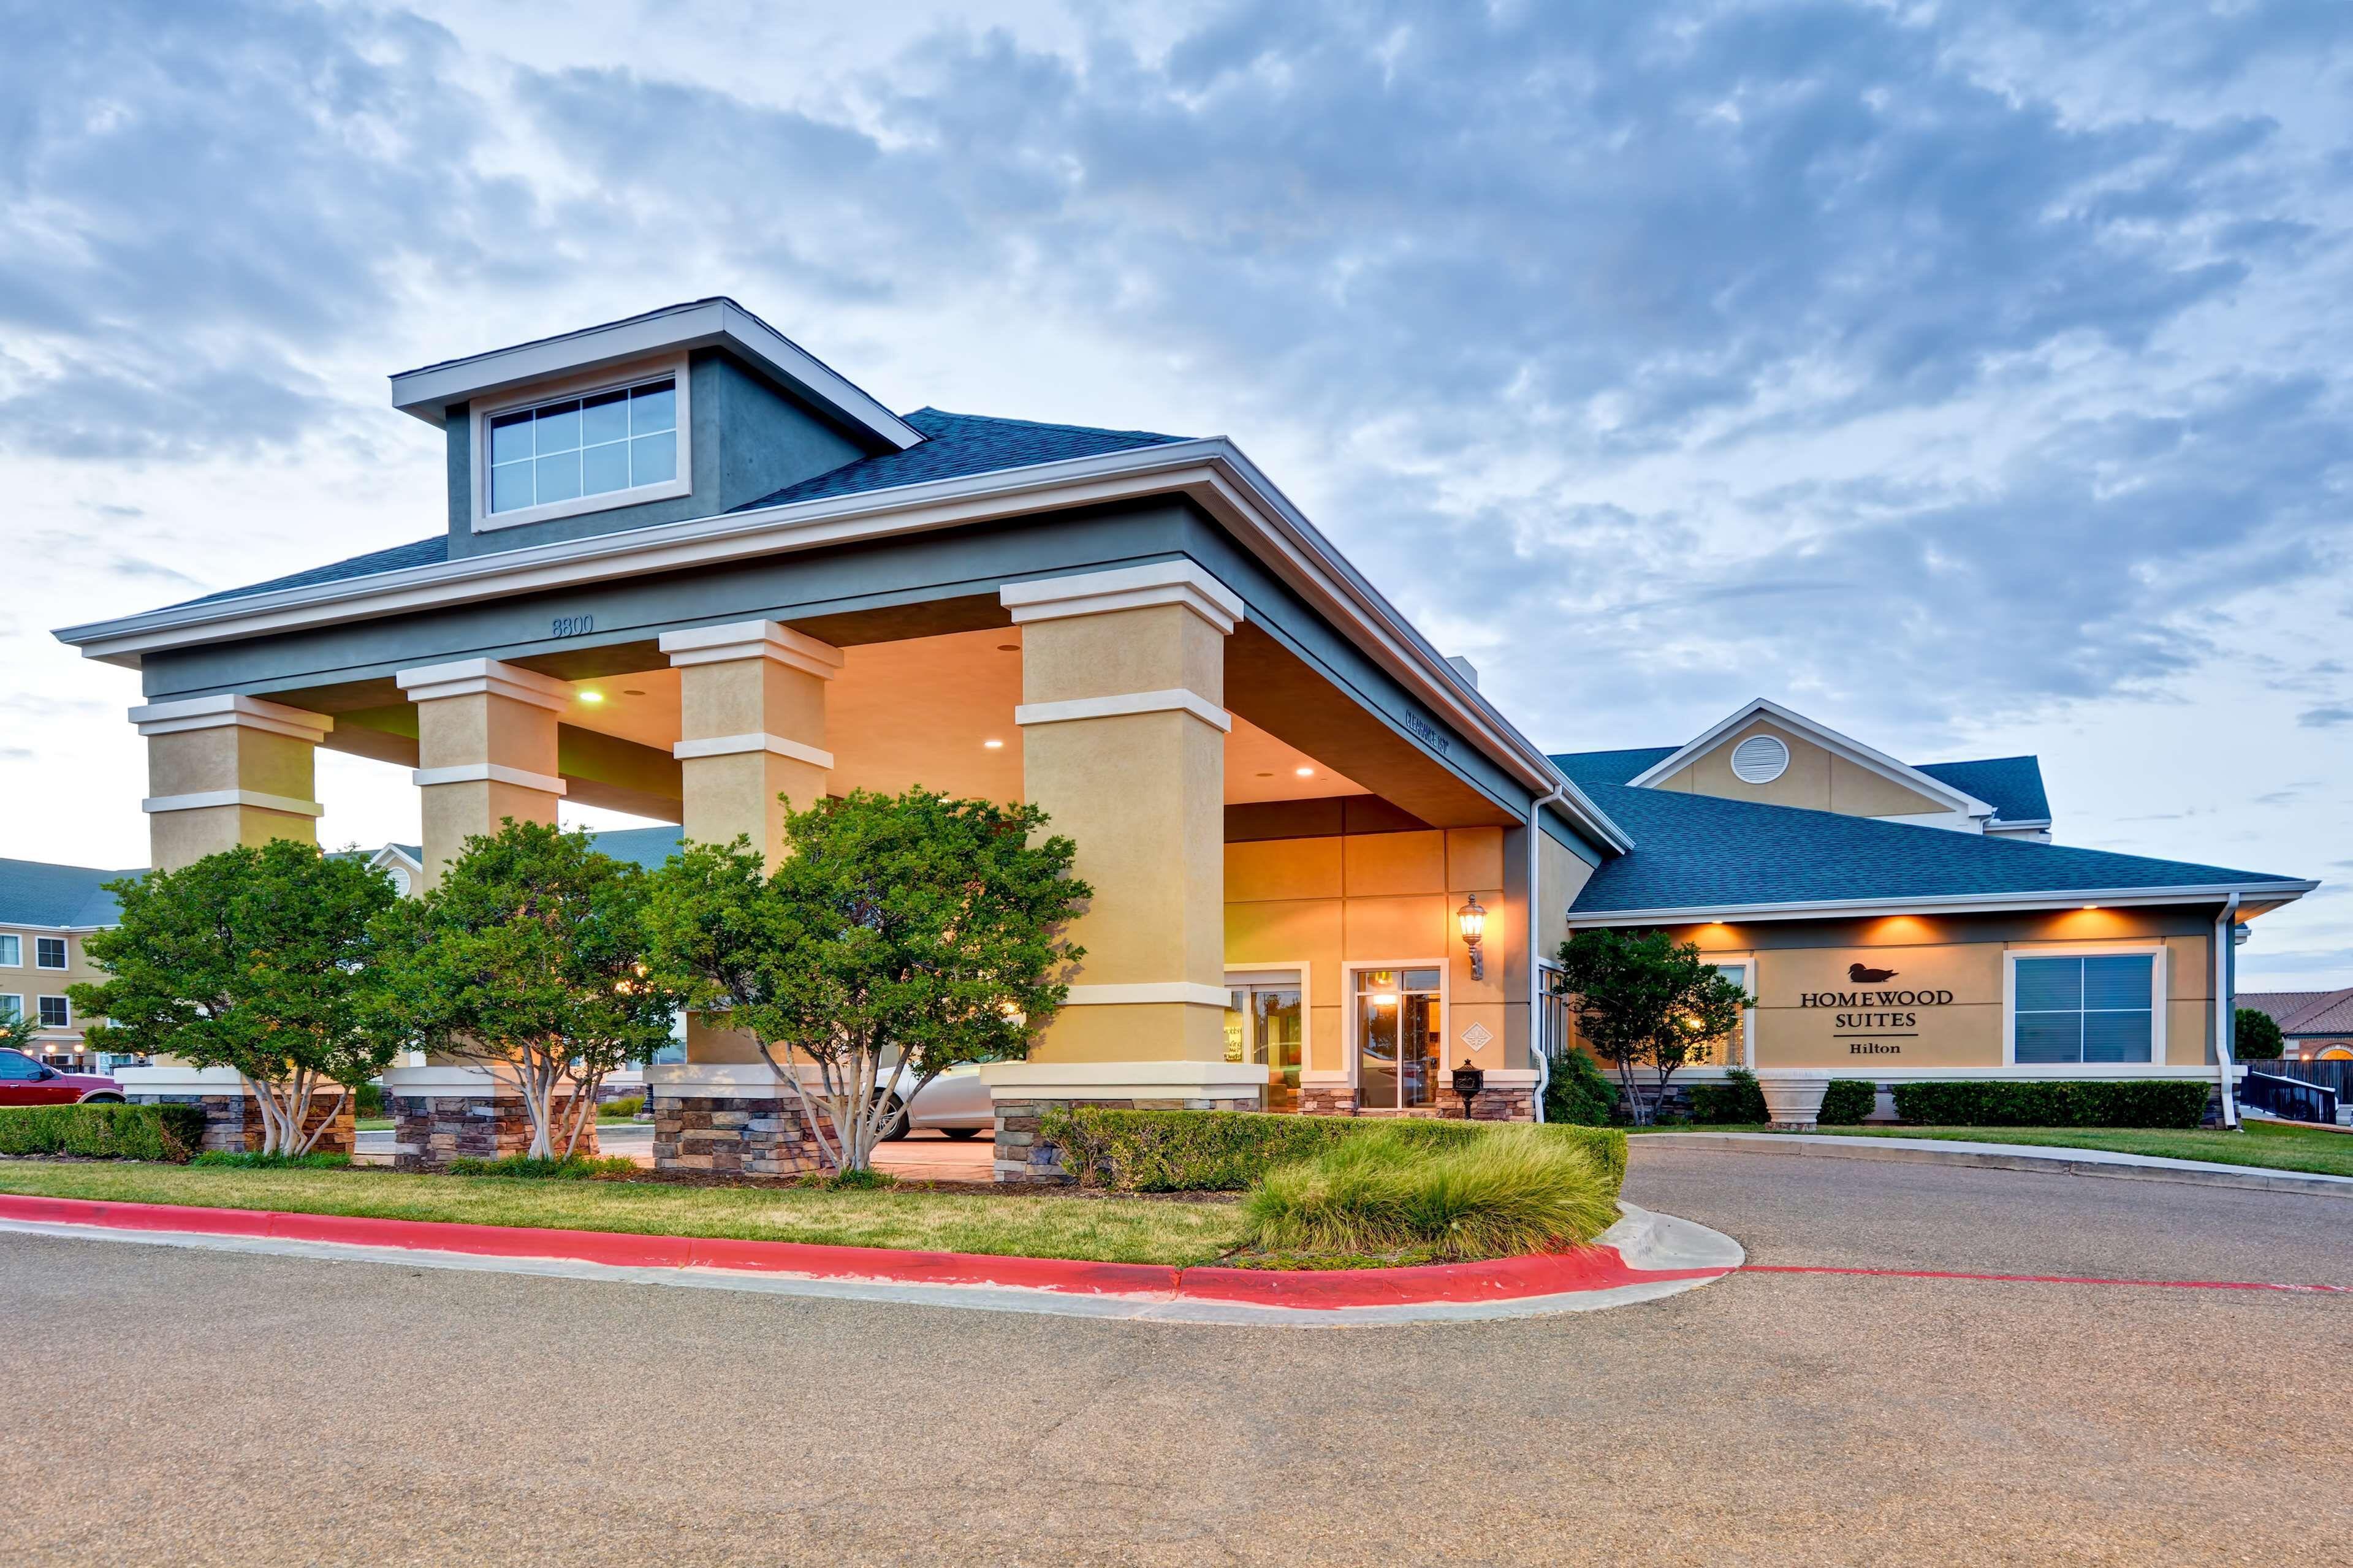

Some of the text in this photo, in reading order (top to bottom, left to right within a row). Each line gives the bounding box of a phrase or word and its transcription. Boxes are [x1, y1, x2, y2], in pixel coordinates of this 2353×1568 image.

[552, 614, 593, 638] 8800
[1405, 710, 1437, 748] CLEARANCE
[1801, 990, 1953, 1007] HOMEWOOD
[1836, 1012, 1916, 1028] SUITES
[1850, 1043, 1901, 1053] Hilton
